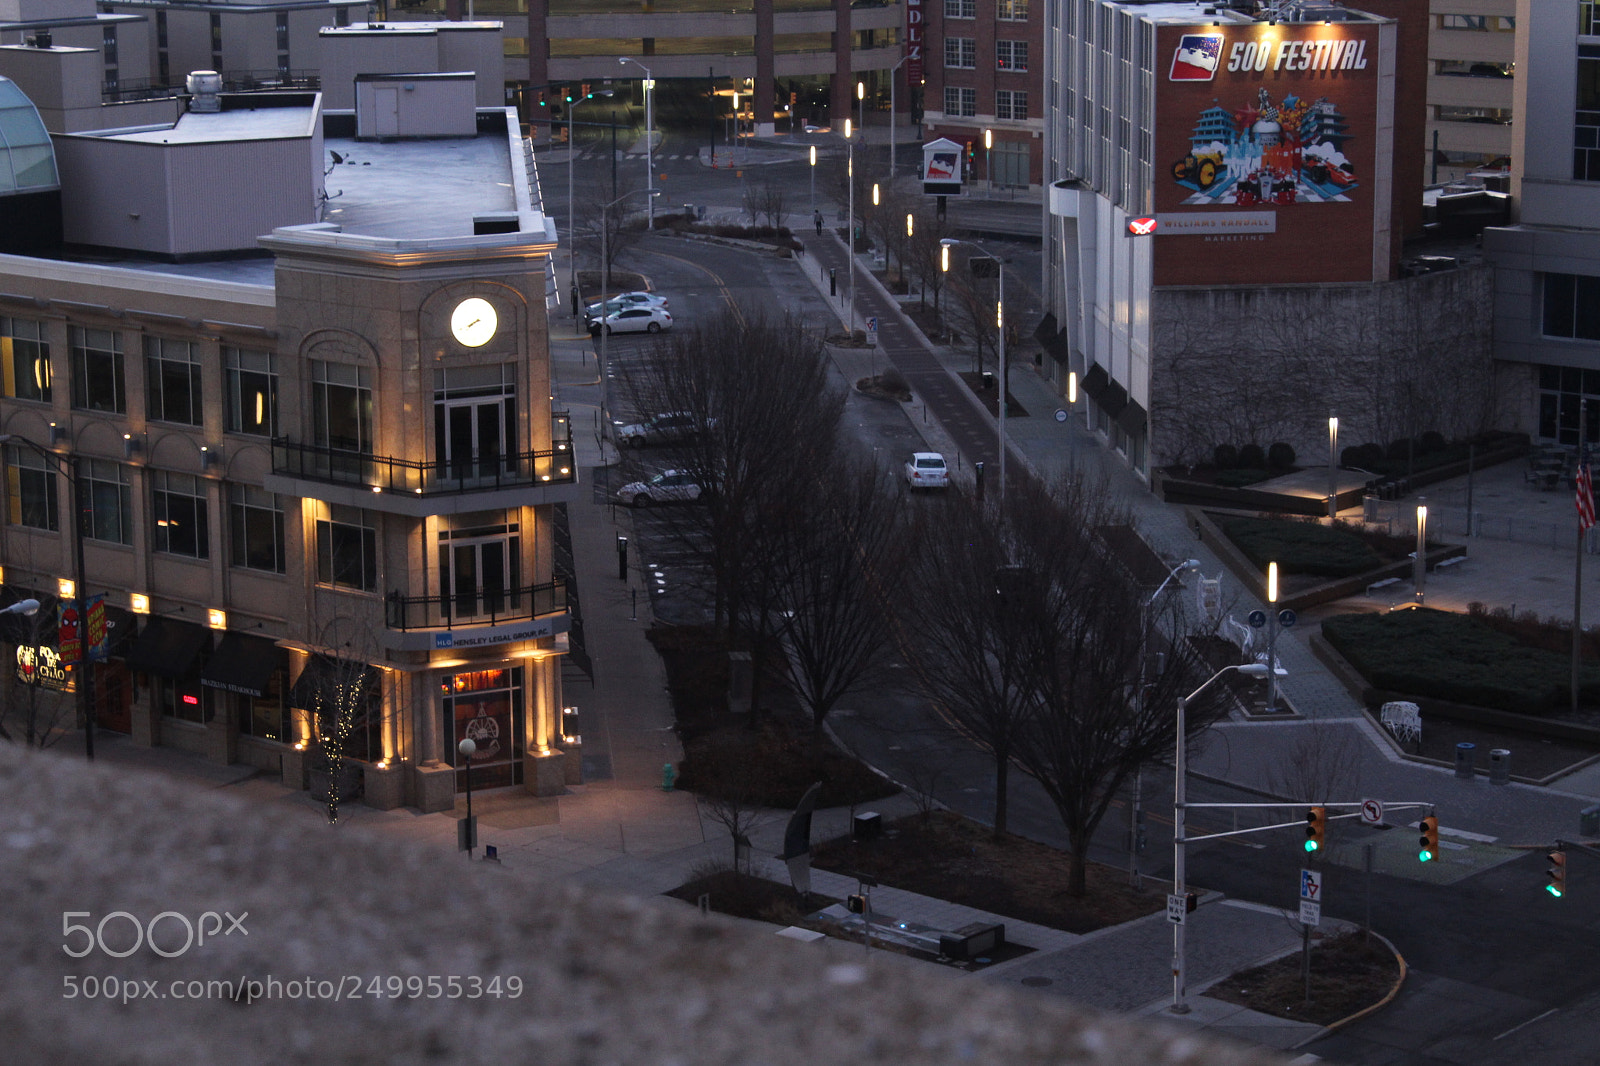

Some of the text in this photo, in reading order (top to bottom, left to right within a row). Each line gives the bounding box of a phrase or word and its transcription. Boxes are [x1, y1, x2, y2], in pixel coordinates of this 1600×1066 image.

[1227, 39, 1367, 72] 500 FESTIVAL
[1164, 218, 1269, 228] WILLIAMS RANDALL
[1204, 234, 1265, 242] MARKETING
[453, 638, 486, 647] HENSLEY
[489, 634, 510, 643] LEGAL
[1169, 896, 1184, 906] ONE
[1168, 905, 1183, 916] WAY
